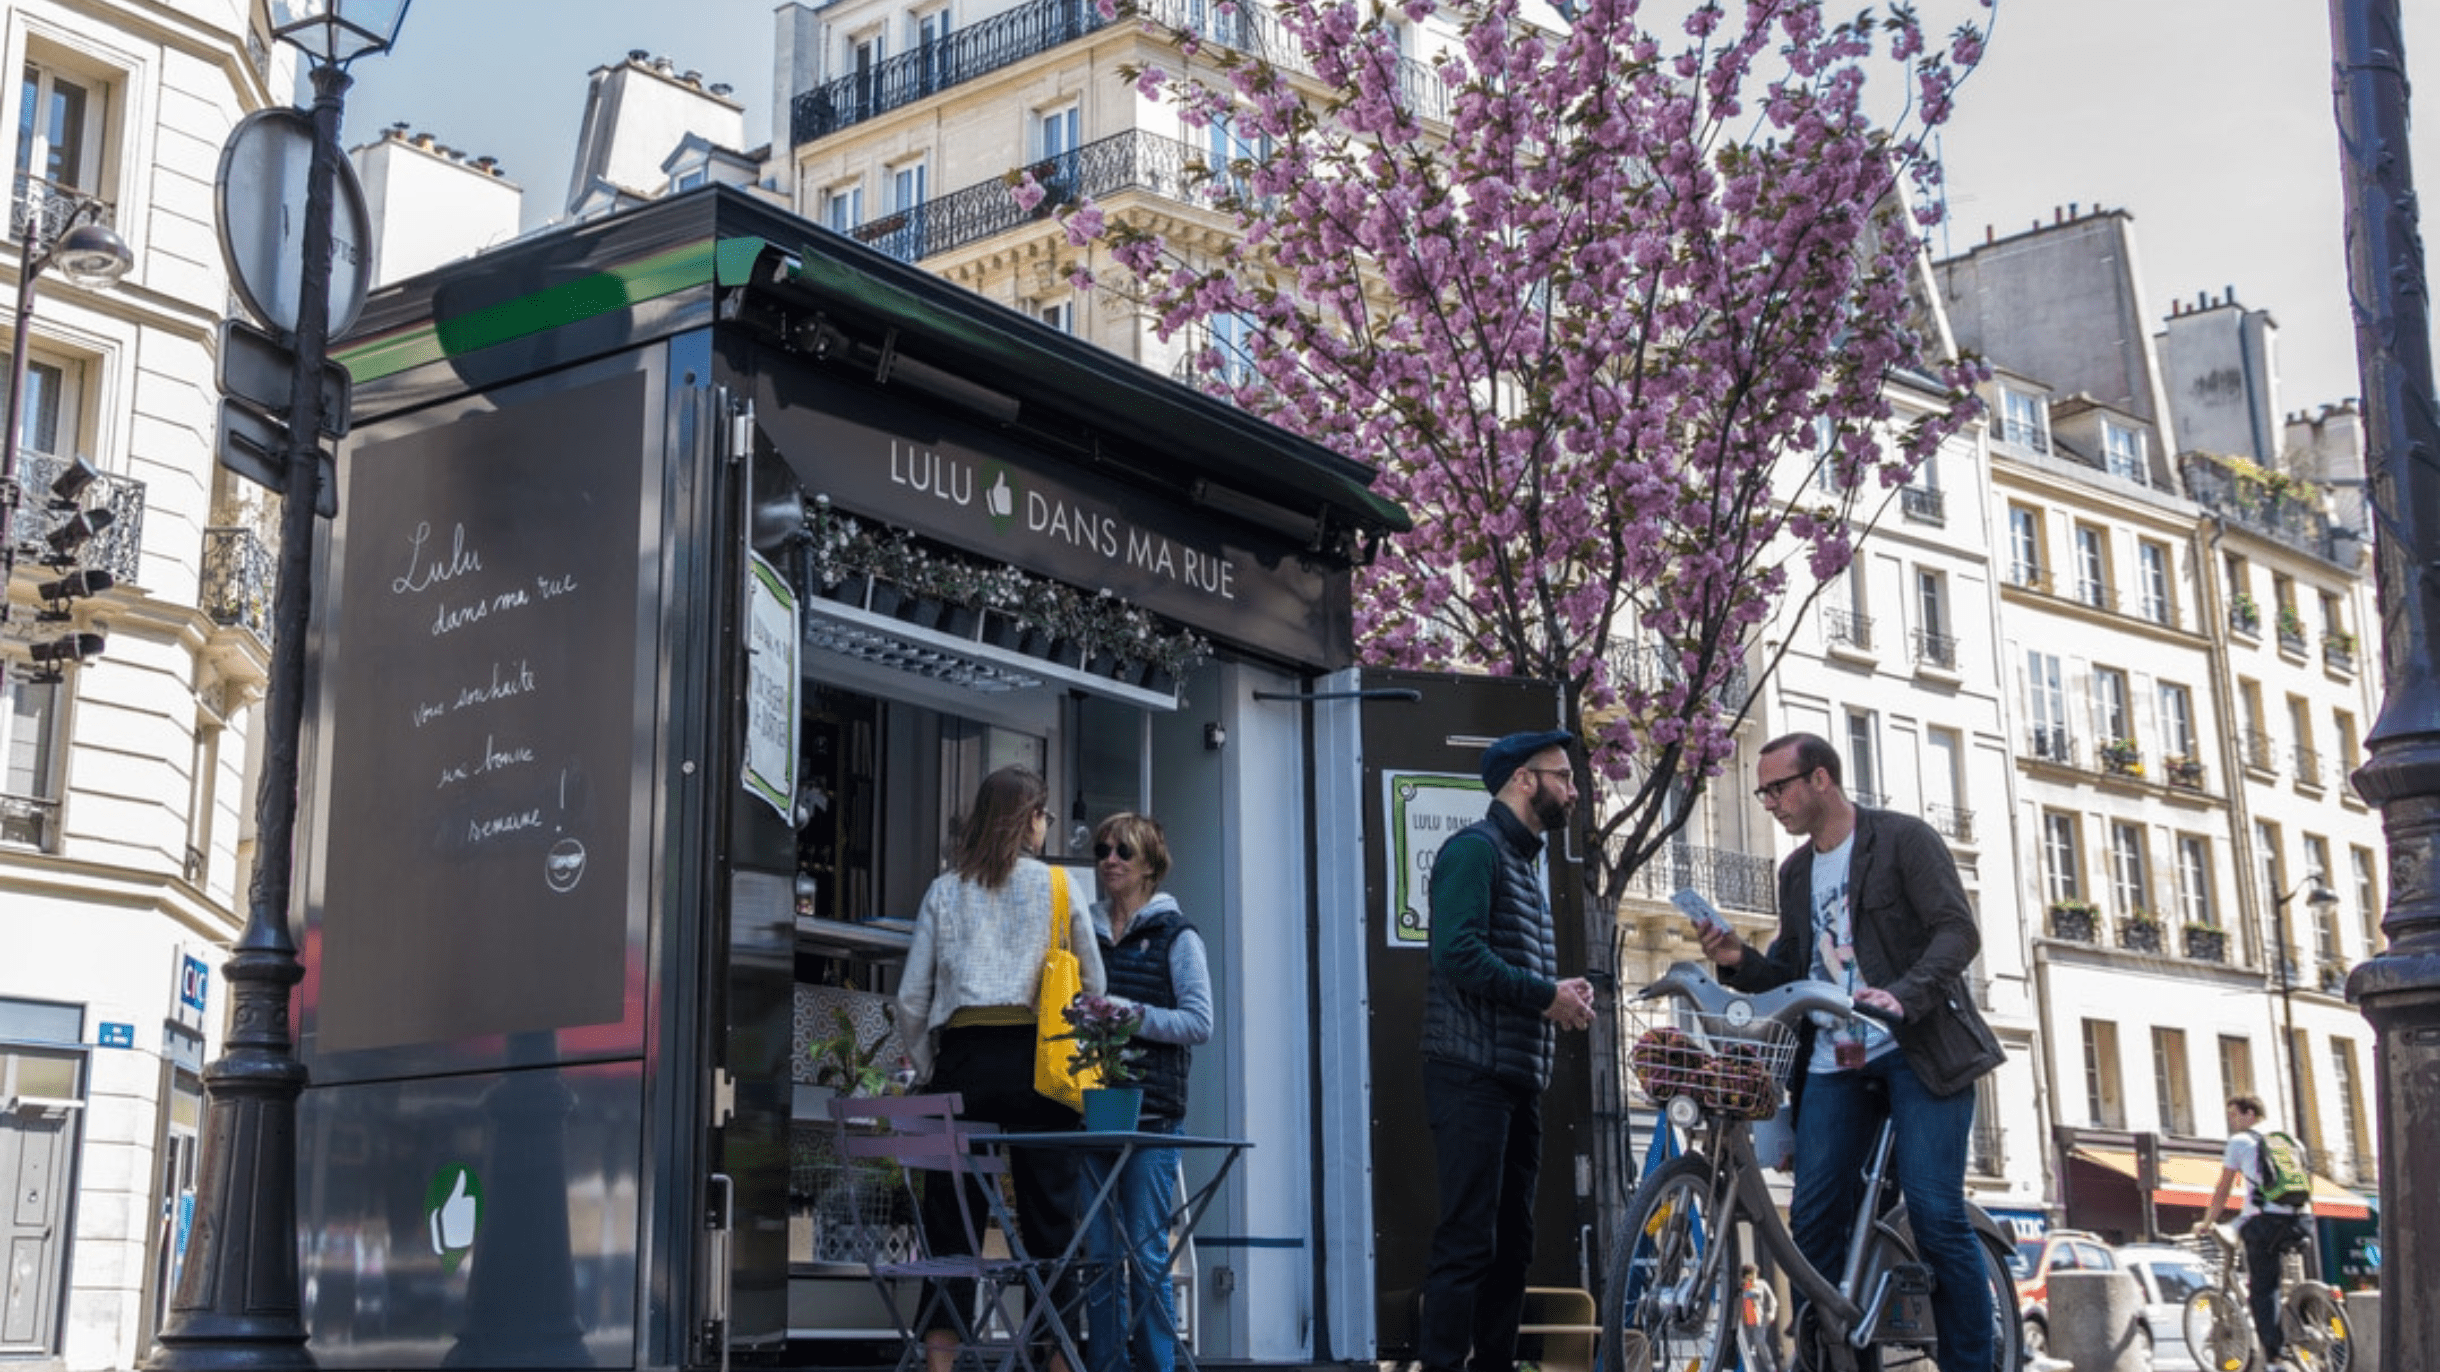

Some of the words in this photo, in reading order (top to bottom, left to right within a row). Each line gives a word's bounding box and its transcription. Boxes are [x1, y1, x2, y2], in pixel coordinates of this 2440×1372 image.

[891, 439, 972, 505] LULU
[1028, 490, 1118, 558] DANS
[1126, 526, 1175, 580] MA
[1184, 547, 1235, 599] RUE
[392, 521, 482, 594] Lulu
[432, 600, 488, 636] dans
[493, 590, 530, 614] ma
[537, 573, 578, 601] rue
[1413, 814, 1441, 830] LULU
